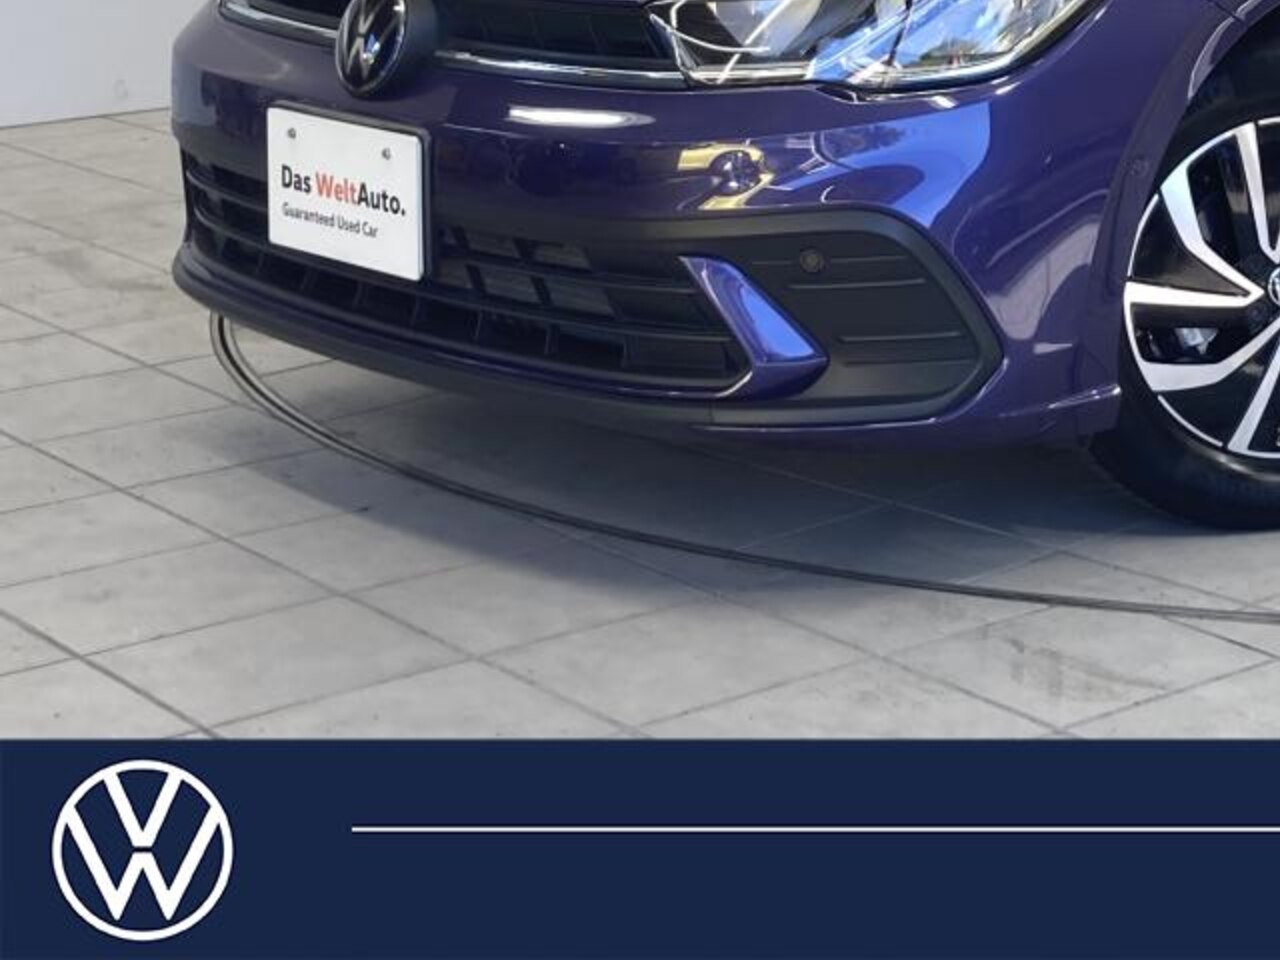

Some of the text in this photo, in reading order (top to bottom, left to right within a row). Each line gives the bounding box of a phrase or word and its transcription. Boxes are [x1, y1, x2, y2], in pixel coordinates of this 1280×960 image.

[281, 164, 406, 216] Das WeltAuto.
[282, 201, 378, 238] Guaranteed Used Car
